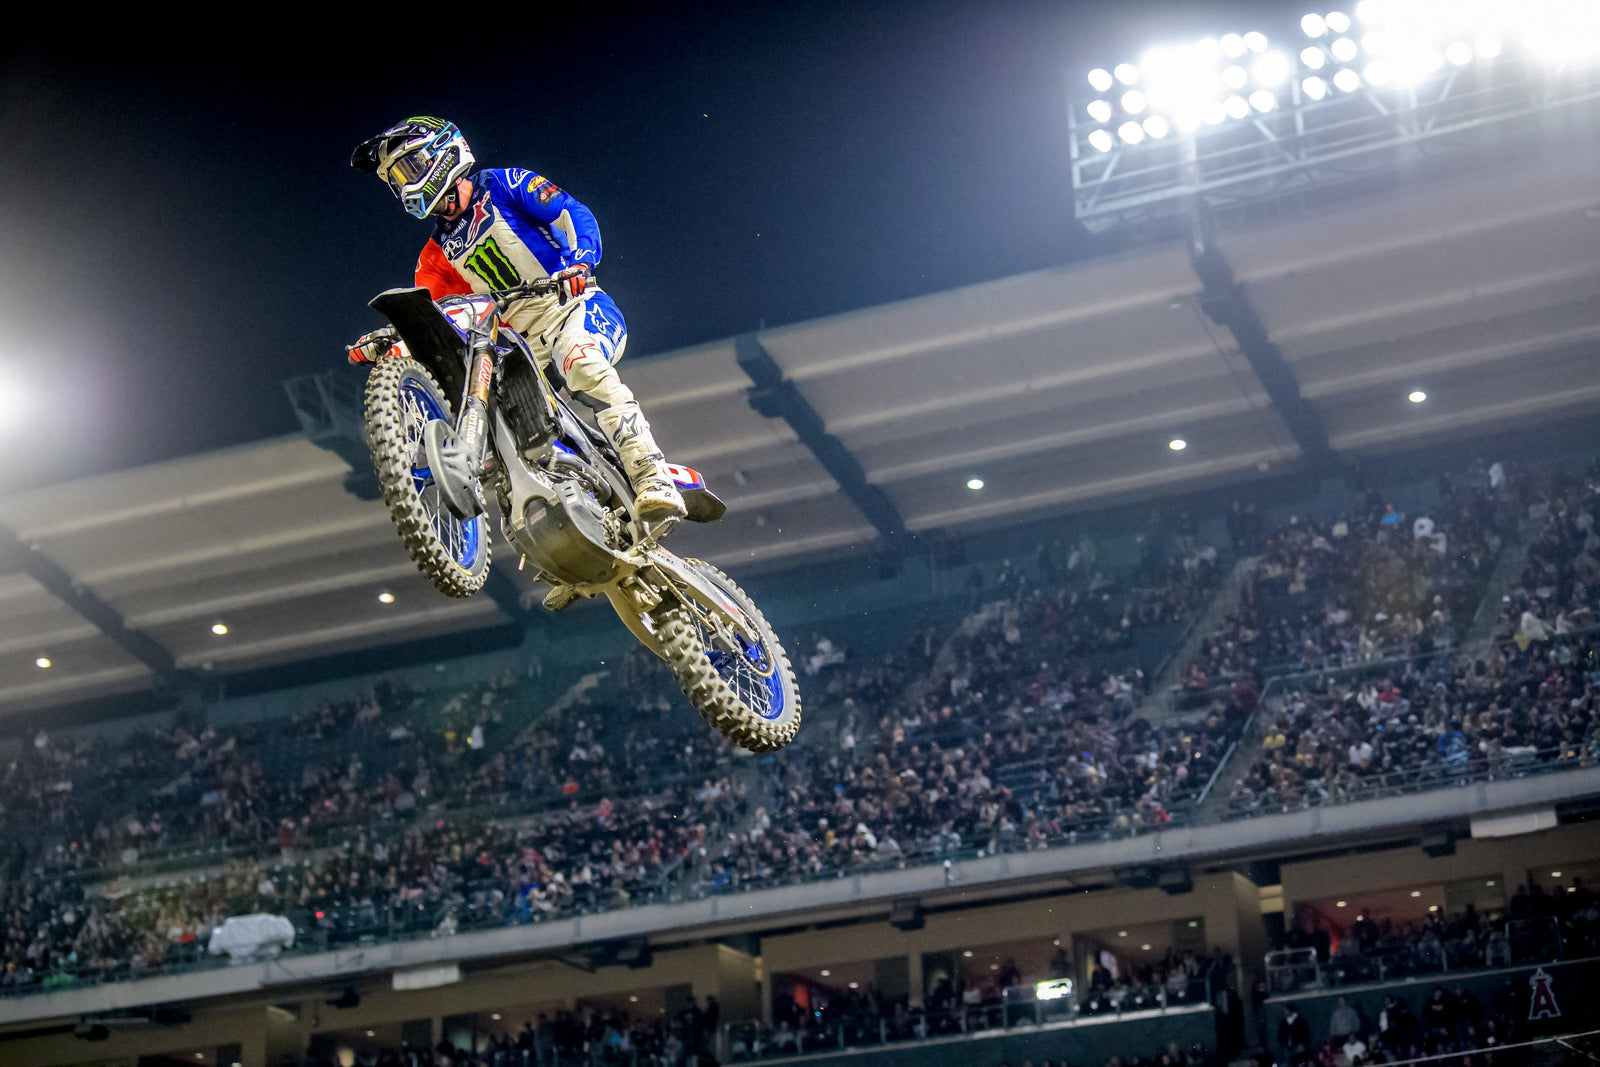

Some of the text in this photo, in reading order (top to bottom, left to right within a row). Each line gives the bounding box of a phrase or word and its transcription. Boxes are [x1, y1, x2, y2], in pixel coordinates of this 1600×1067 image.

[430, 151, 456, 183] MONSTER
[480, 357, 493, 388] KYB
[466, 408, 479, 445] DUNLOP
